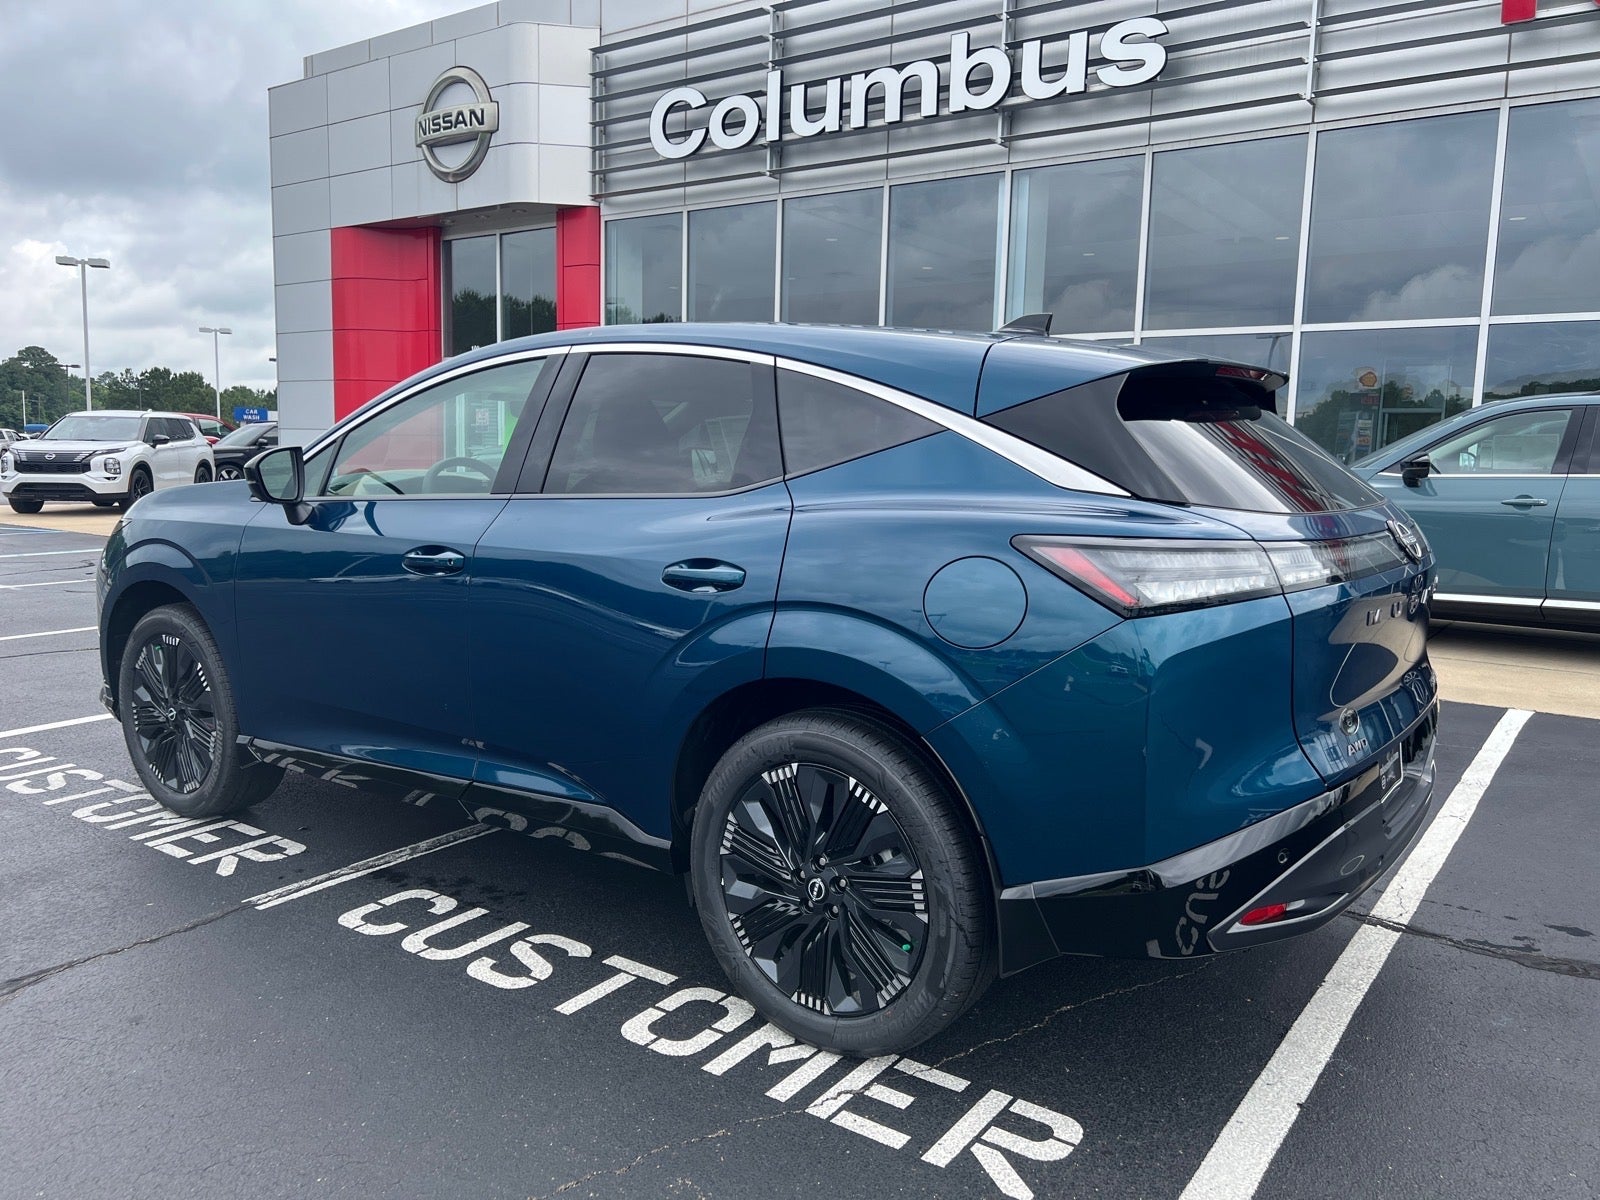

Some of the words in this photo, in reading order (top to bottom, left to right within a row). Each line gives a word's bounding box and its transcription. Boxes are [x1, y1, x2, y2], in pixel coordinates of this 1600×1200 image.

[418, 108, 485, 137] NISSAN
[649, 17, 1168, 159] Columbus
[1347, 737, 1368, 757] AWD
[337, 888, 1083, 1200] CUSTOMER
